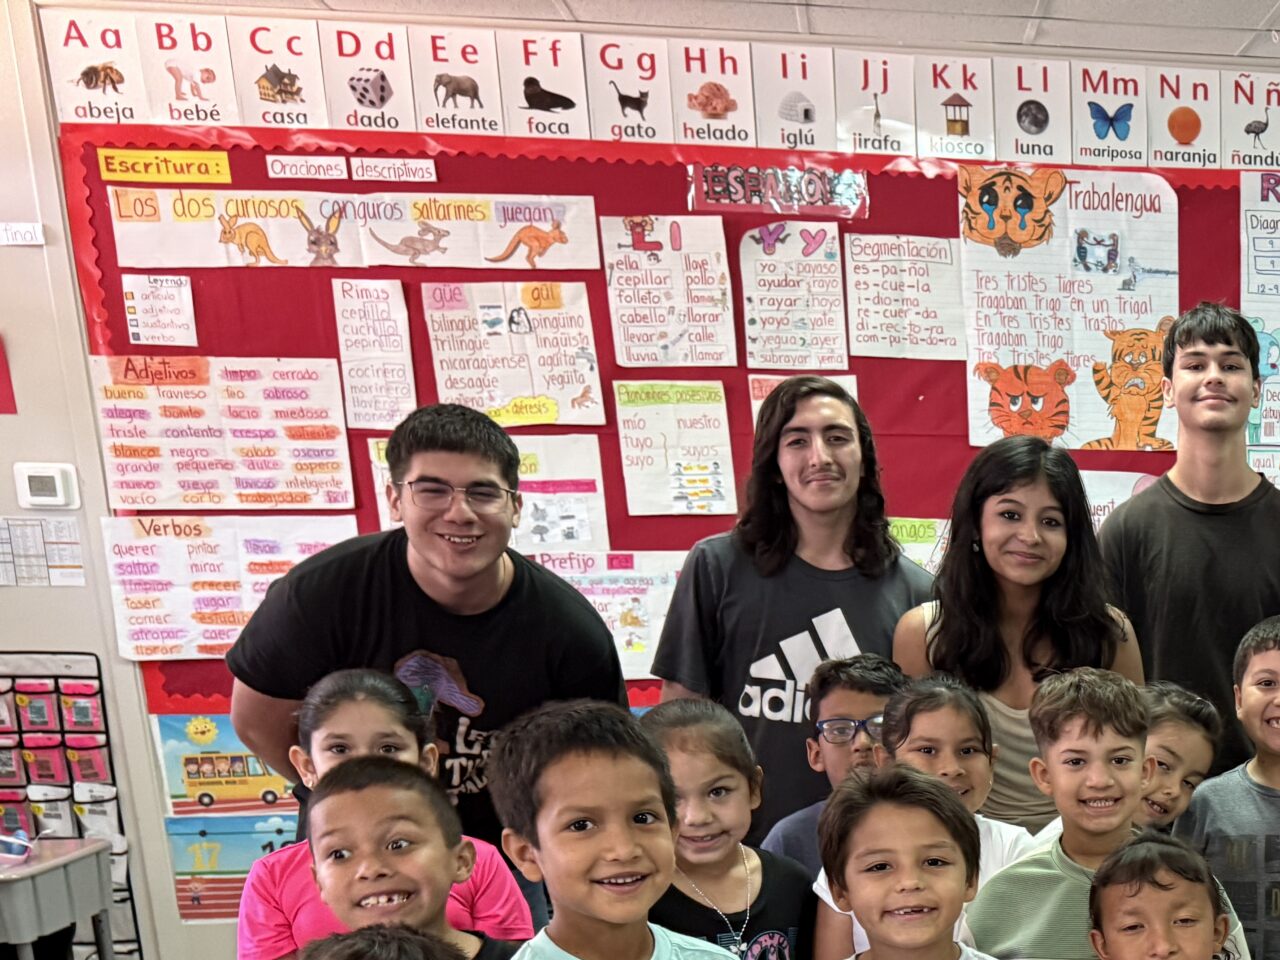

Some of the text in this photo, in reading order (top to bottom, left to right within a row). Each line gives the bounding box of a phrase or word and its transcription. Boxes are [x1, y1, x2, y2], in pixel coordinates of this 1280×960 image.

[74, 102, 135, 123] abeja
[168, 104, 221, 123] bebé
[262, 108, 308, 126] casa
[346, 109, 399, 130] dado
[424, 114, 499, 133] elefante
[527, 116, 570, 136] foca
[610, 122, 657, 142] gato
[683, 121, 748, 141] helado
[780, 126, 816, 149] iglú
[852, 131, 901, 155] jirafa
[929, 135, 985, 156] kiosco
[1015, 137, 1054, 157] luna
[1079, 142, 1142, 163] mariposa
[1153, 147, 1217, 166] naranja
[104, 156, 221, 175] Escritura:
[271, 159, 433, 180] Oraciones descriptivas
[115, 188, 555, 228] Los dos curiosos canguros saltarines juegan
[1066, 180, 1161, 218] Trabalengua
[852, 238, 948, 261] Segmentación
[616, 255, 639, 270] ella
[760, 262, 776, 273] yo
[617, 270, 670, 287] cepillar
[758, 273, 802, 291] ayudar
[974, 270, 998, 291] Tres
[341, 282, 390, 300] Rimas
[618, 289, 661, 304] folleto
[431, 314, 479, 335] bilingüe
[532, 314, 585, 335] pingüino
[123, 357, 197, 384] Adjetivos
[272, 368, 319, 381] cerrado
[104, 386, 144, 400] bueno
[157, 385, 207, 399] travieso
[110, 424, 146, 438] triste
[165, 424, 223, 438] contento
[677, 413, 721, 430] nuestro
[170, 447, 210, 461] negro
[116, 460, 160, 477] grande
[137, 518, 202, 537] Verbos
[113, 542, 157, 558] querer
[540, 552, 595, 574] Prefijo
[128, 613, 173, 626] comer
[738, 679, 811, 723] adi
